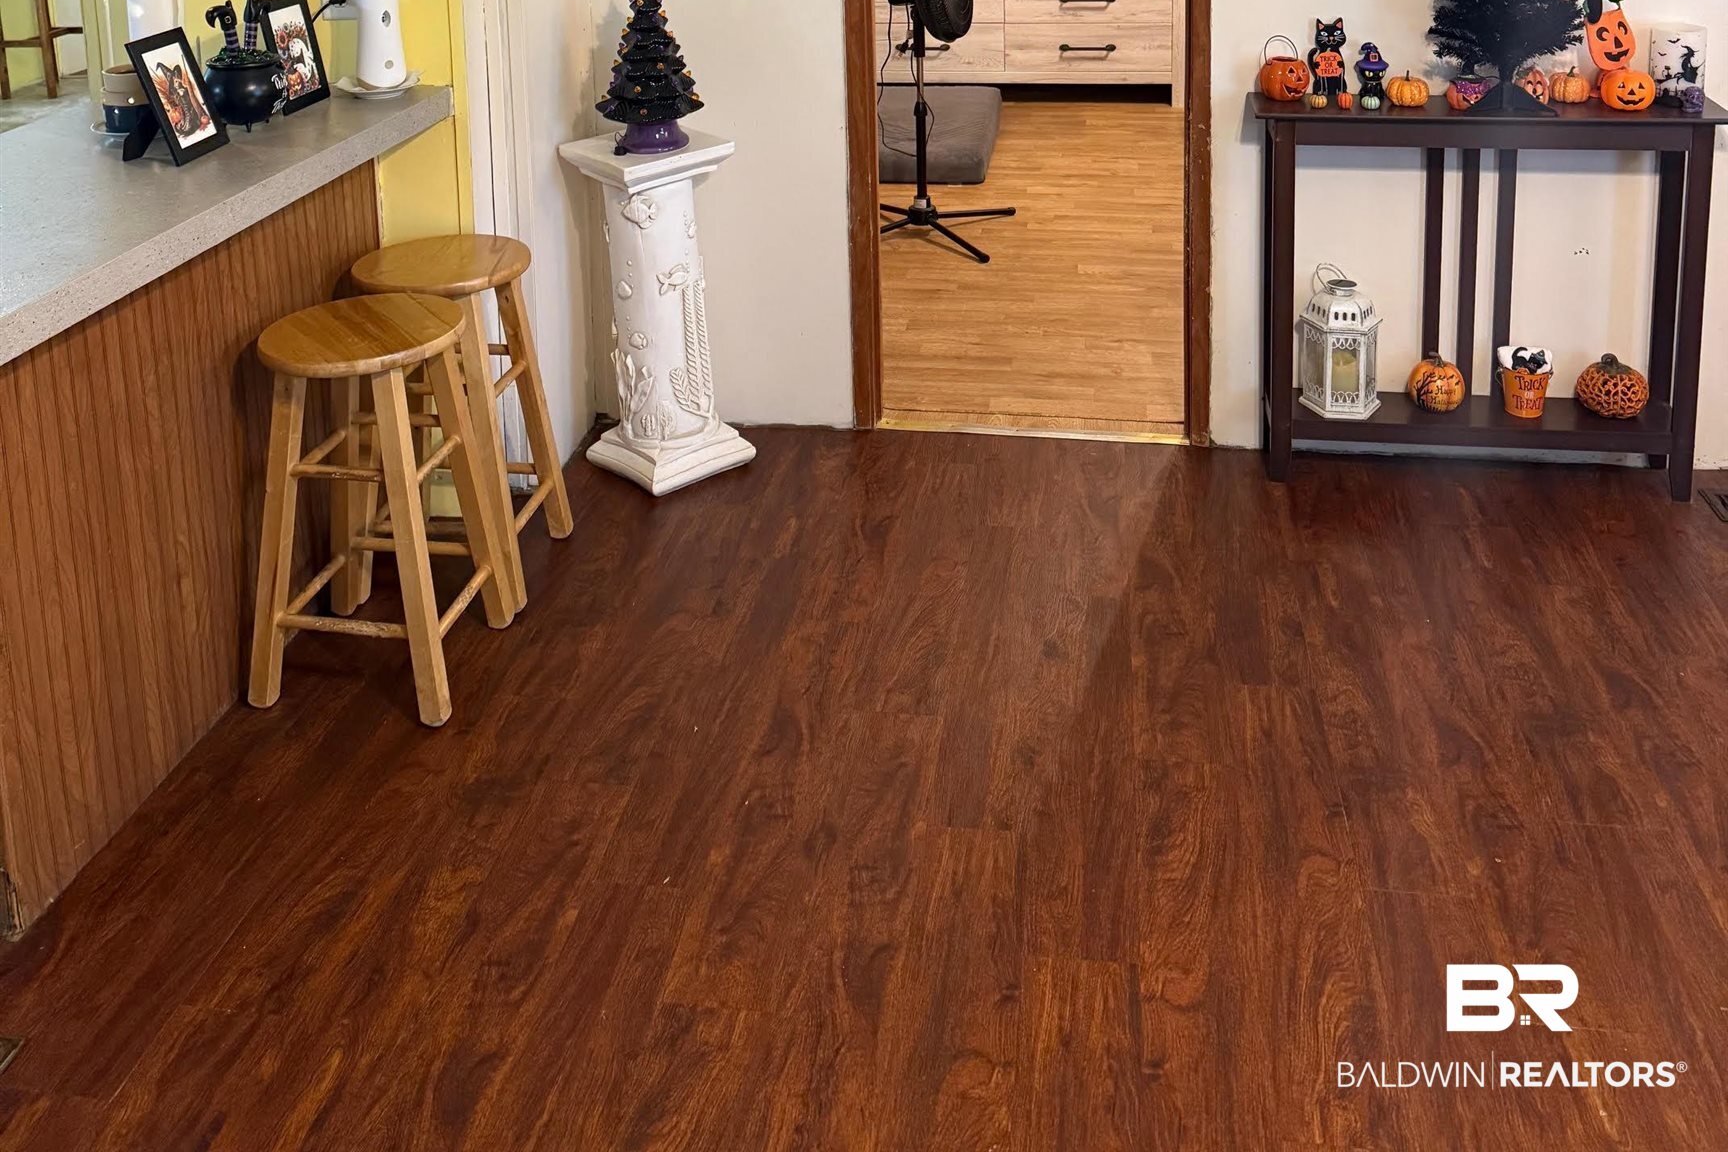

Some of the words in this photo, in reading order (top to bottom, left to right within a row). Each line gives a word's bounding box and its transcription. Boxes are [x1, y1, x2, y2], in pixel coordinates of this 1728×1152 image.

[1320, 55, 1338, 63] TRICK
[1514, 375, 1546, 391] TRICK
[1512, 394, 1544, 410] TREAT
